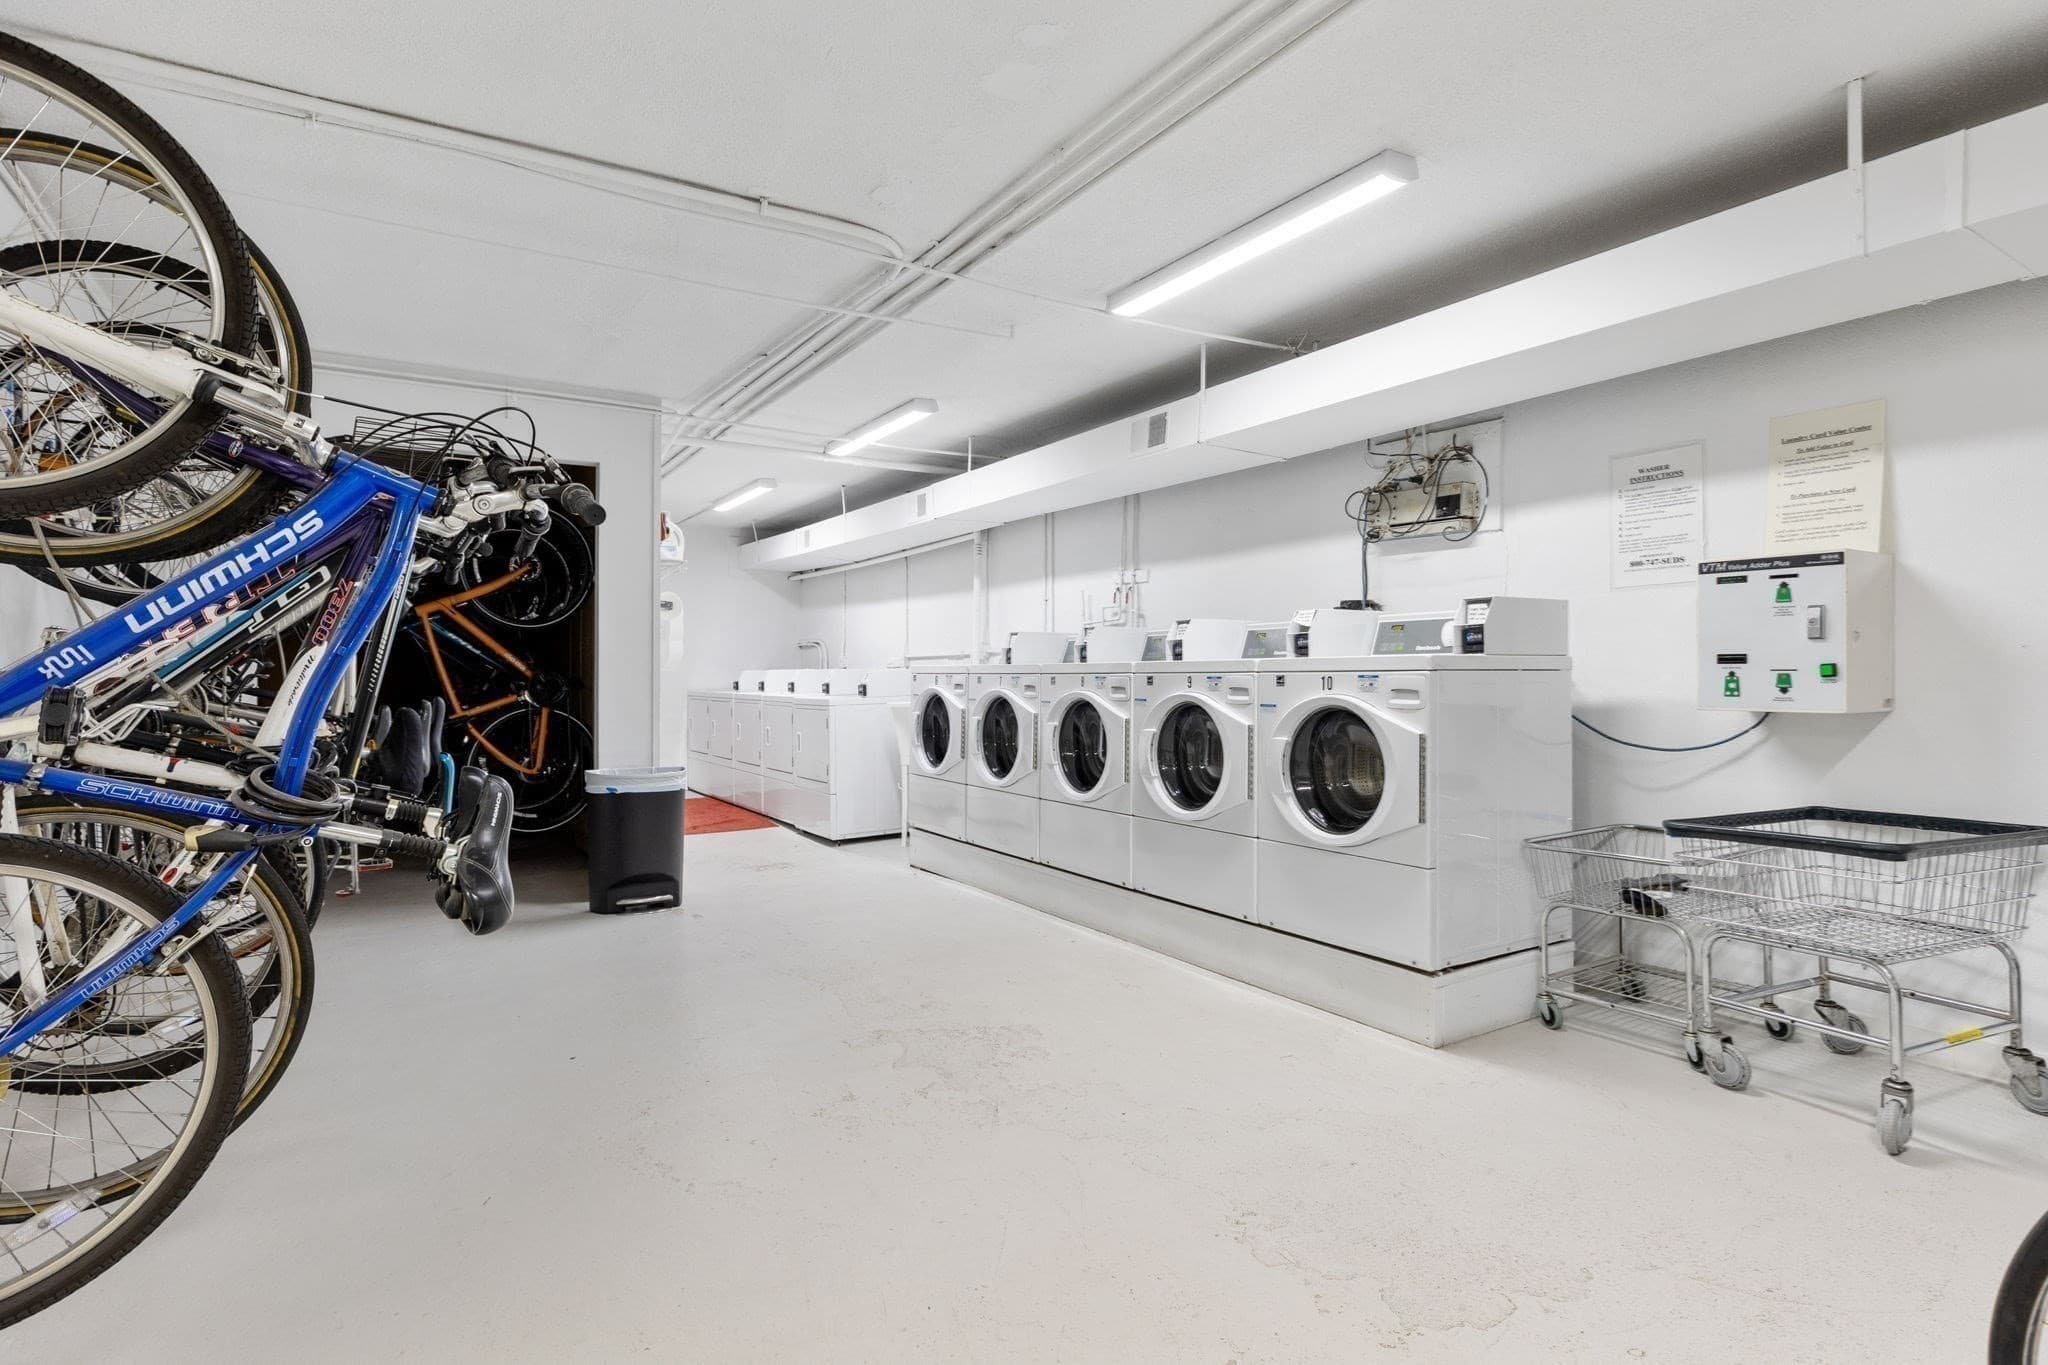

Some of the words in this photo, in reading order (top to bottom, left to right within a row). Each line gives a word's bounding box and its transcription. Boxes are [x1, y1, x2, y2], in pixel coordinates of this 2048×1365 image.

[1781, 435, 1808, 445] Laundry
[1809, 431, 1827, 440] Card
[1827, 428, 1847, 437] Value
[1848, 424, 1872, 433] Center
[1629, 469, 1685, 485] INSTRUCTIONS
[1638, 464, 1670, 474] WASHER
[123, 509, 325, 635] SCHWINN
[1701, 562, 1728, 573] VTM
[1727, 563, 1748, 571] Value
[1749, 560, 1772, 569] Adder
[1773, 559, 1791, 567] Plus
[248, 565, 331, 634] GT
[311, 577, 354, 646] 7300
[1320, 675, 1333, 691] 10
[76, 778, 241, 820] SCHWINN
[79, 917, 181, 1000] SCHWINN
